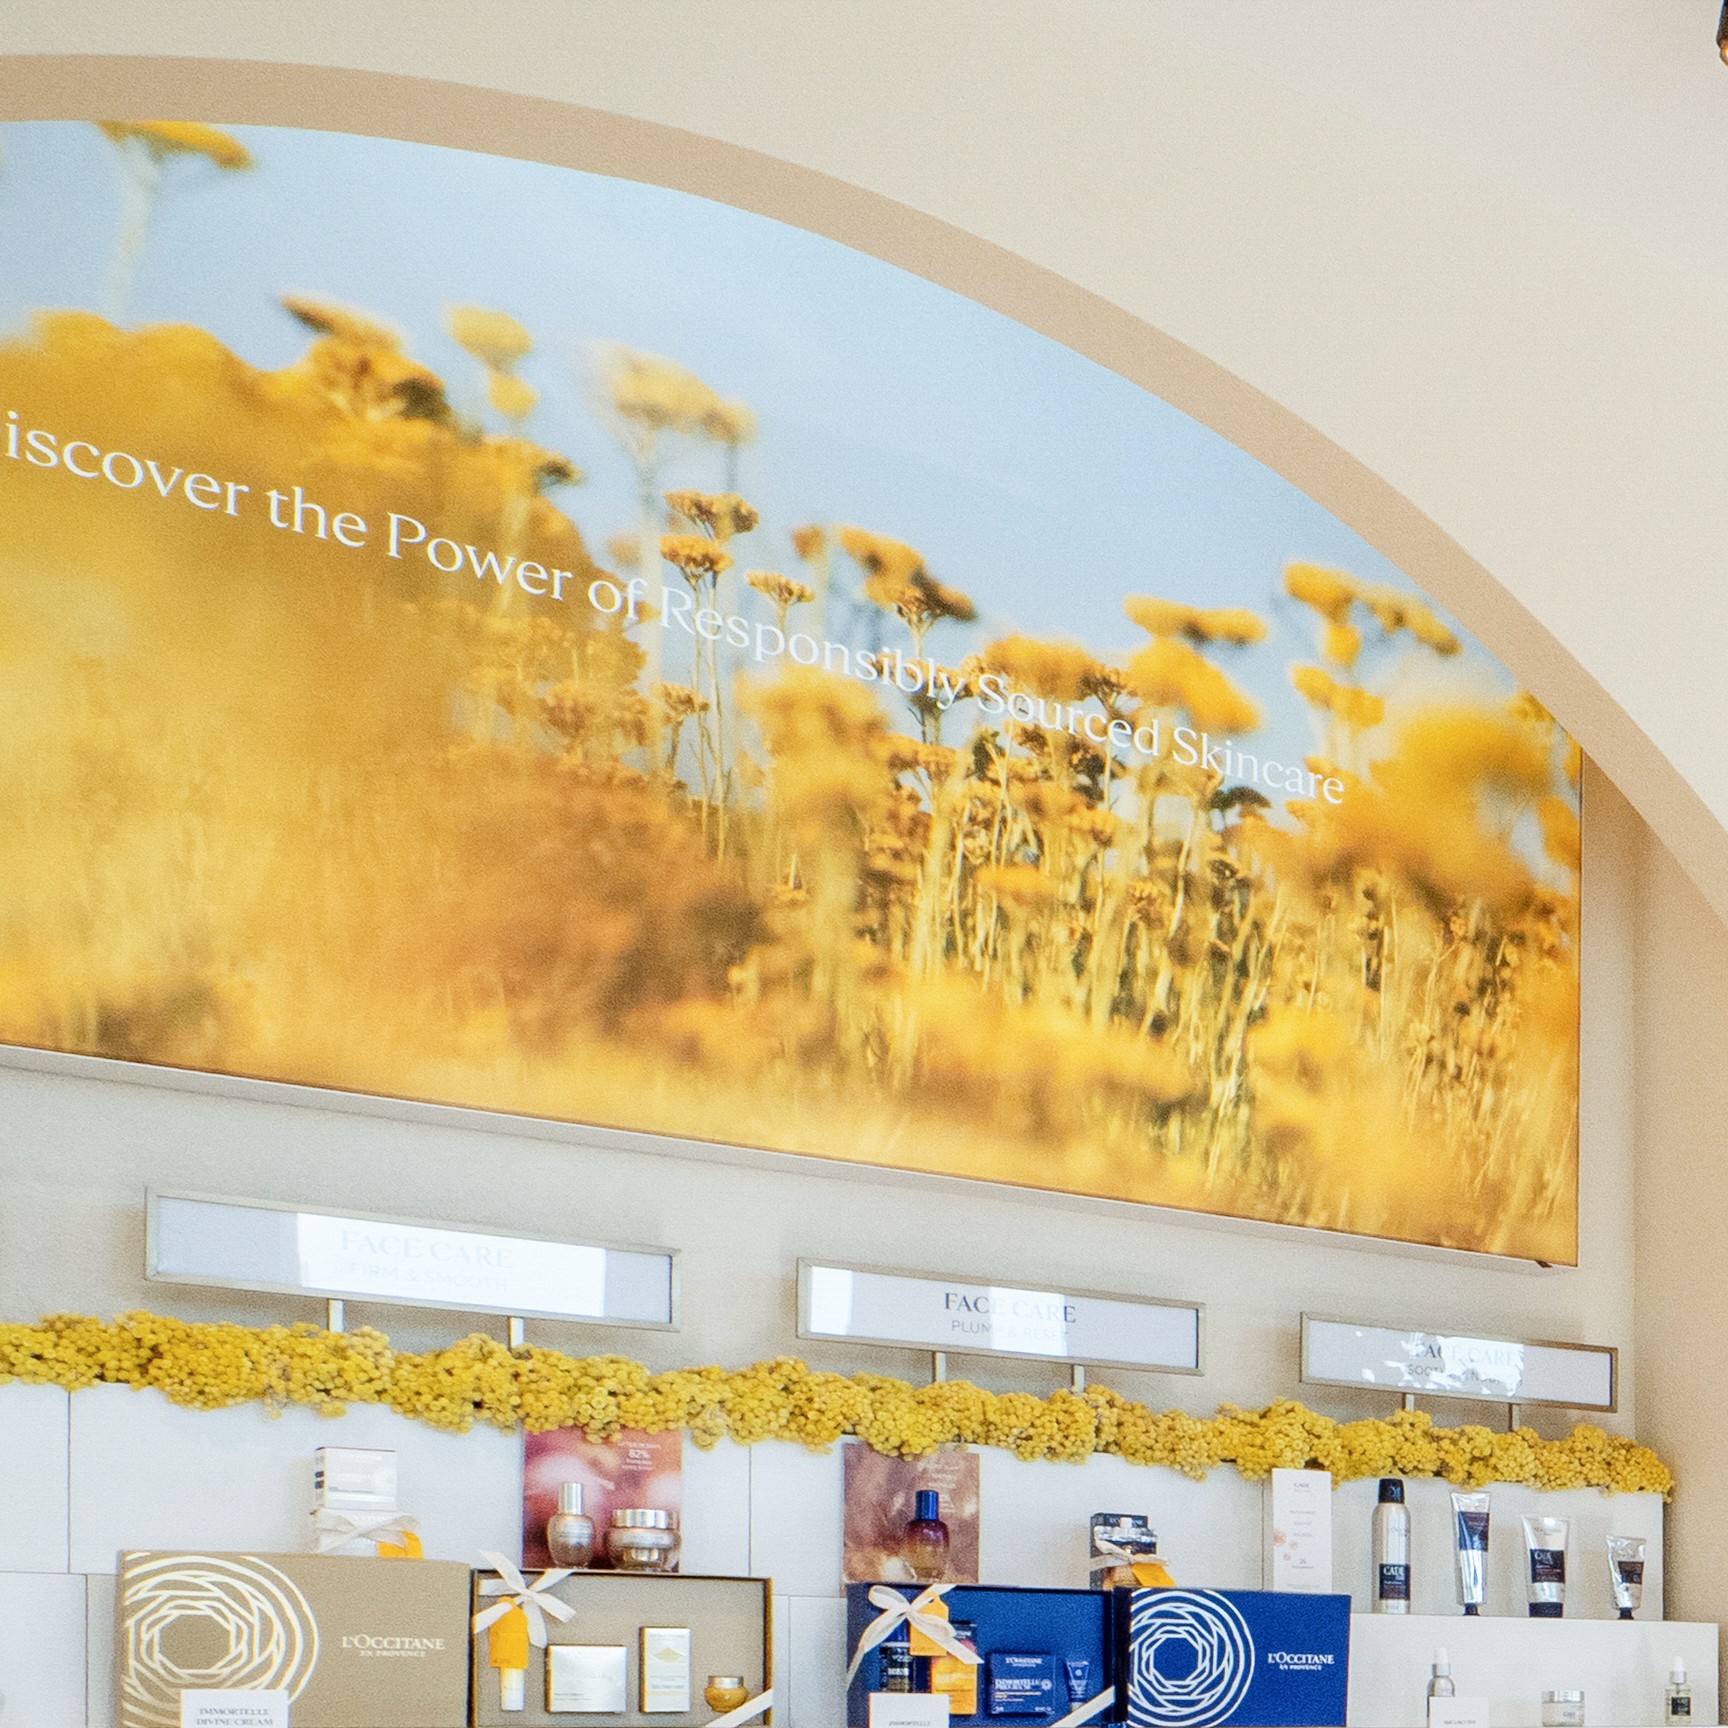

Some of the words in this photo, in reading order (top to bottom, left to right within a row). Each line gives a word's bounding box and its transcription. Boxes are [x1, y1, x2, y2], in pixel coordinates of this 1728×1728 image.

[3, 411, 249, 516] iscover
[265, 487, 367, 547] the
[386, 513, 572, 601] Power
[589, 578, 648, 620] of
[660, 585, 965, 710] Responsibly
[978, 673, 1160, 757] Sourced
[1173, 727, 1345, 805] Skincare
[341, 1229, 423, 1259] FACE
[429, 1240, 514, 1269] CARE
[944, 1291, 1005, 1317] FACE
[1013, 1301, 1077, 1324] CARE
[342, 1634, 446, 1651] L'OCCITANE
[1268, 1651, 1335, 1665] L'OCCITANE
